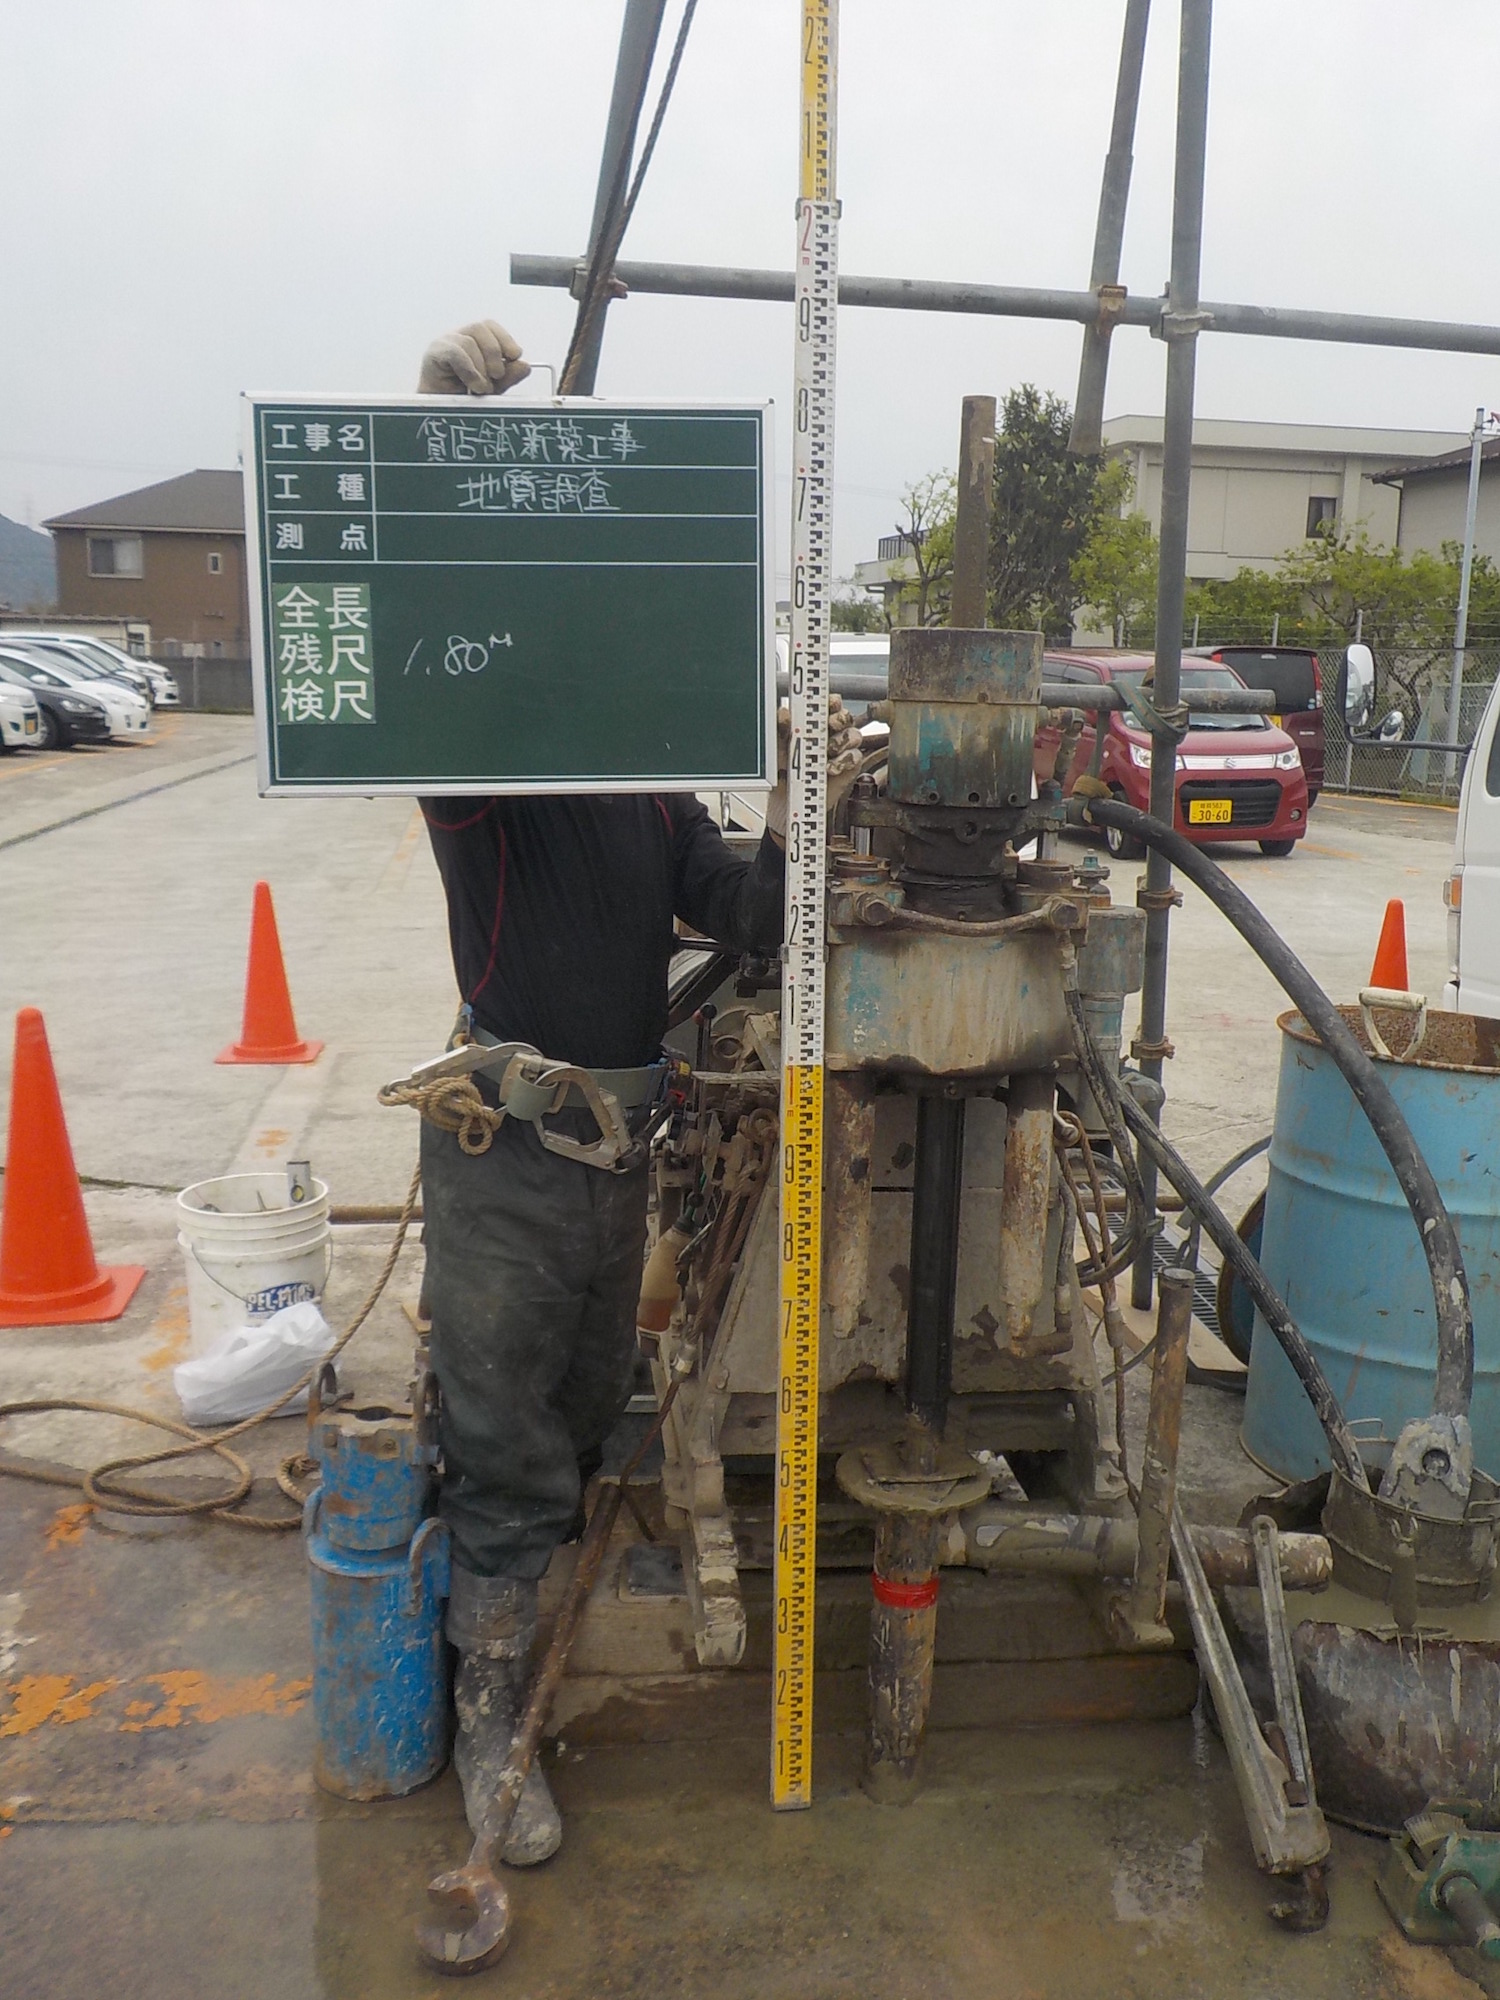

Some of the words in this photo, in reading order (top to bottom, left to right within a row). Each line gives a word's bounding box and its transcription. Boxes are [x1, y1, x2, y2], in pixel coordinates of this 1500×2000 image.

[804, 16, 814, 64] 2
[804, 111, 811, 158] 1
[802, 205, 812, 251] 2
[800, 297, 810, 343] 9
[271, 423, 365, 452] 工事名
[456, 468, 621, 513] 地質調査
[797, 477, 807, 522] 7
[277, 585, 368, 629] 全長
[795, 565, 805, 609] 6
[279, 632, 371, 675] 残尺
[793, 652, 803, 695] 5
[281, 679, 373, 722] 検尺
[792, 737, 801, 780] 4
[790, 821, 800, 863] 3
[789, 904, 799, 945] 2
[788, 984, 795, 1026] 1
[785, 1144, 795, 1184] 9
[784, 1223, 793, 1262] 8
[783, 1300, 793, 1339] 7
[781, 1376, 791, 1414] 6
[780, 1450, 790, 1488] 5
[779, 1524, 788, 1561] 4
[778, 1598, 788, 1634] 3
[777, 1670, 787, 1706] 2
[777, 1740, 784, 1776] 1
